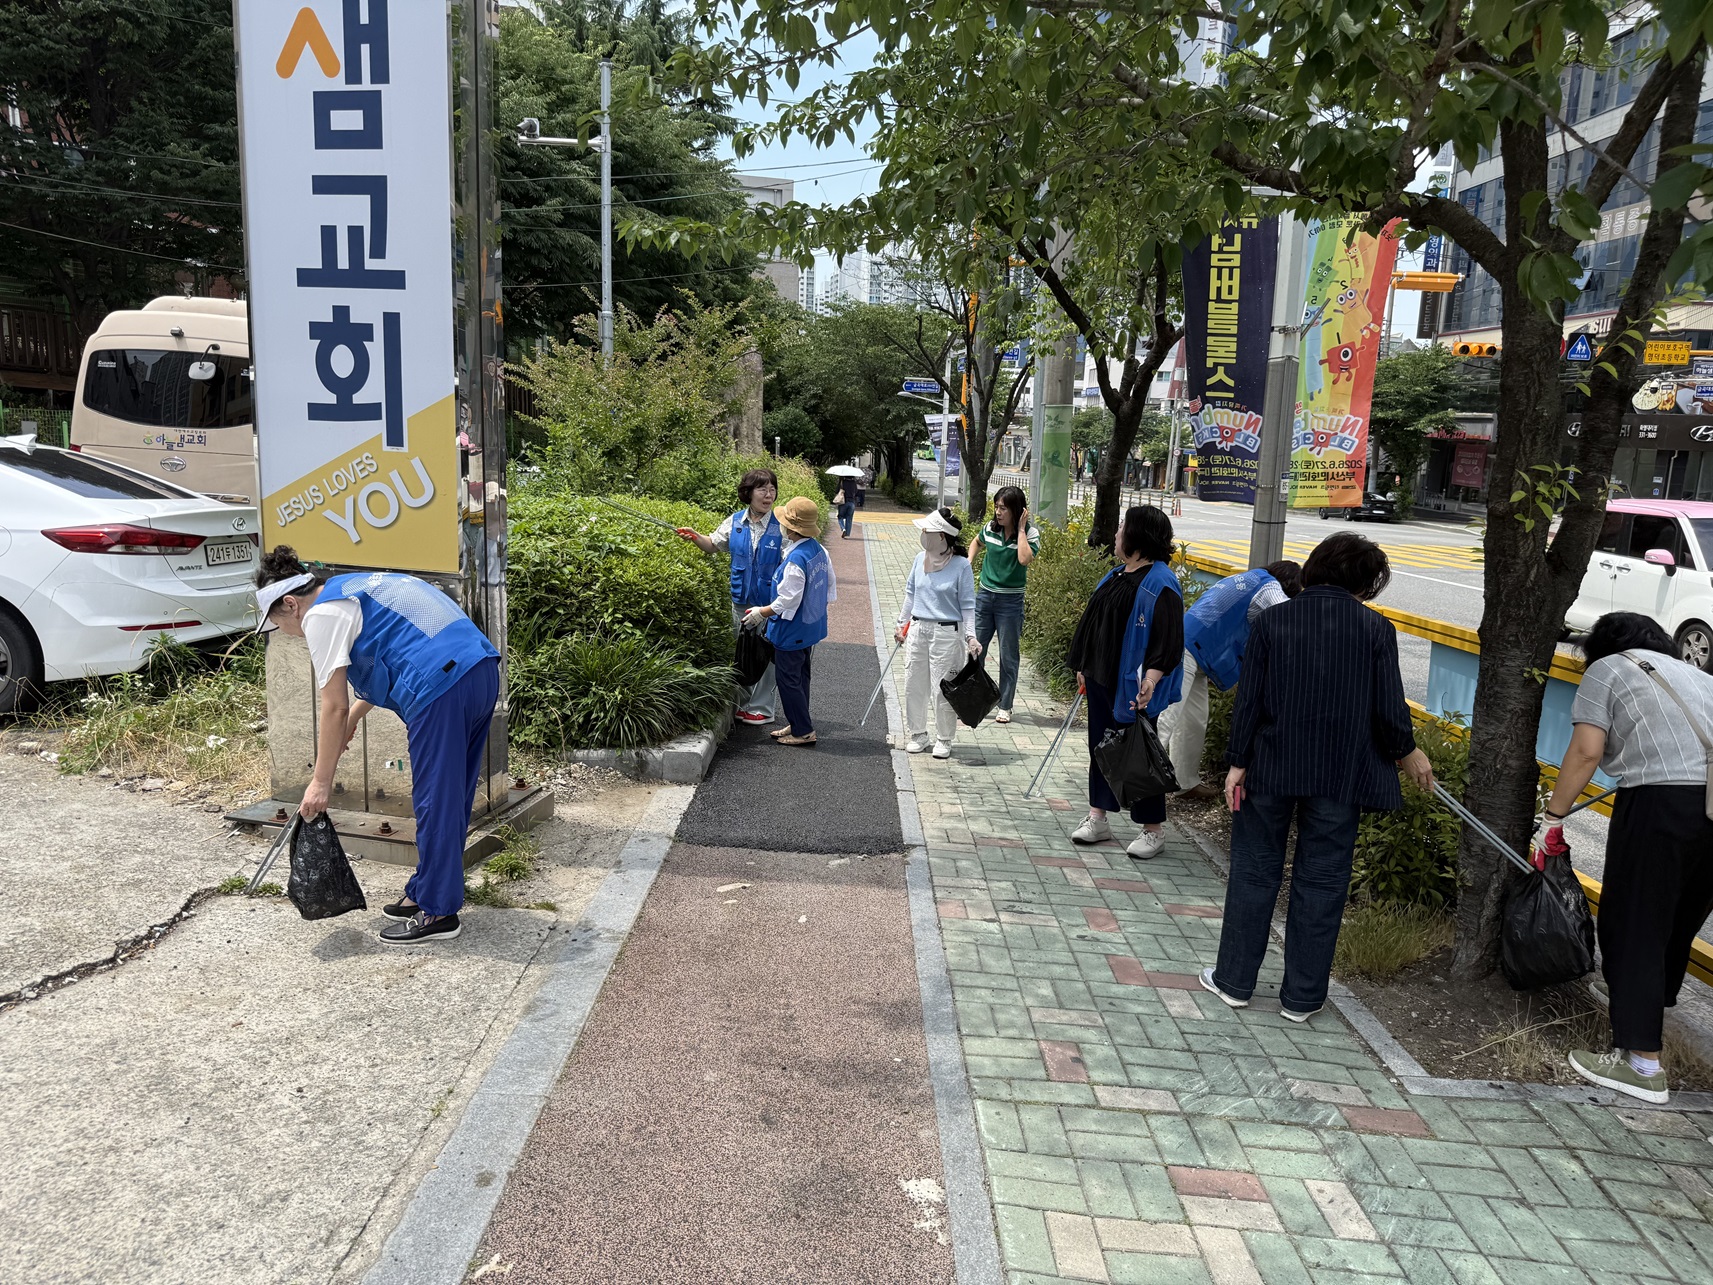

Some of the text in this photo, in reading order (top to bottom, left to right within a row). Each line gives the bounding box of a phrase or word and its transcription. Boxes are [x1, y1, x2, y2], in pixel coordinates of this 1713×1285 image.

[276, 452, 379, 527] JESUS LOVES
[321, 456, 436, 545] YOU
